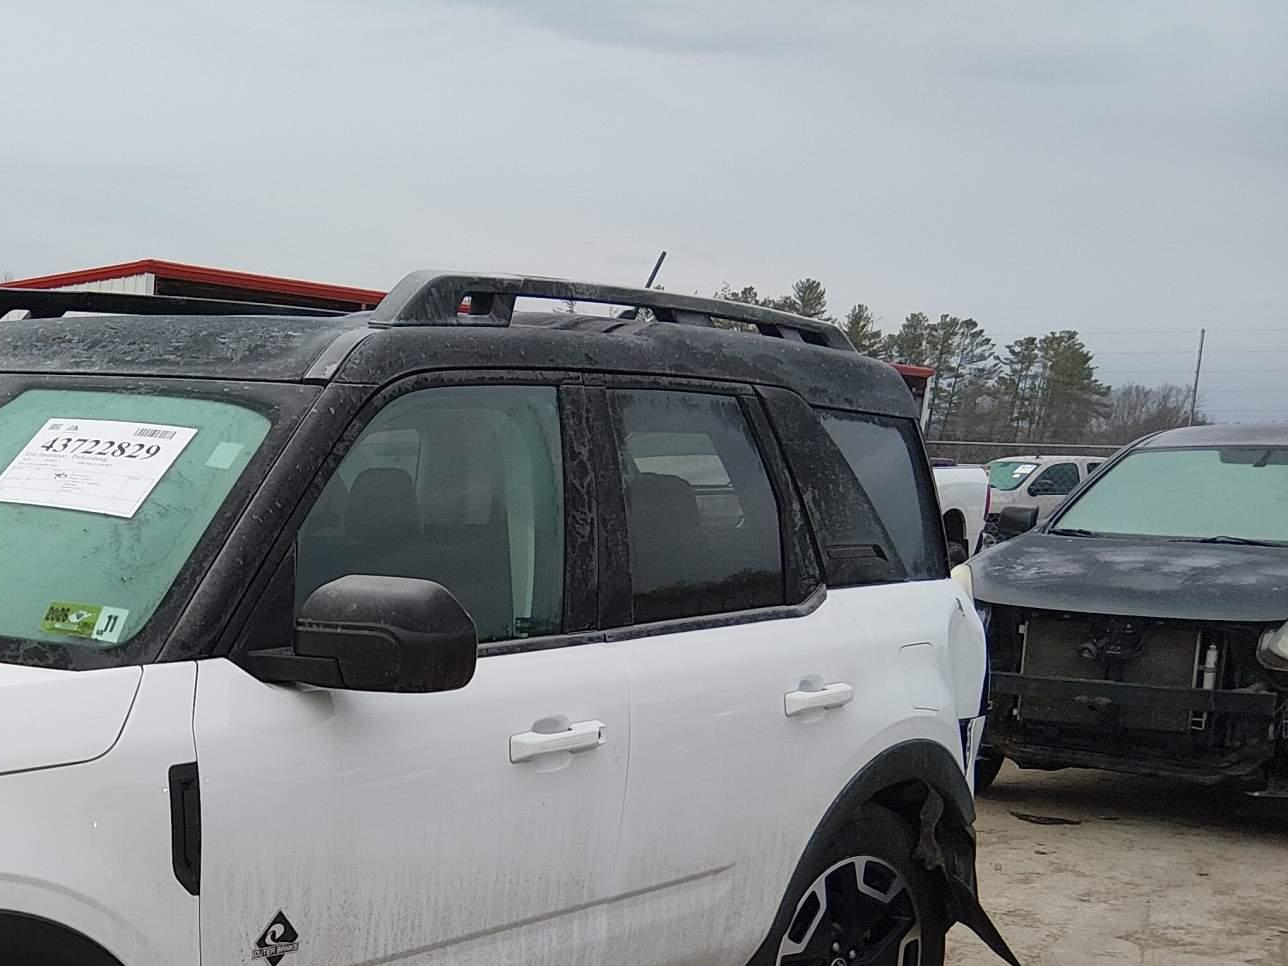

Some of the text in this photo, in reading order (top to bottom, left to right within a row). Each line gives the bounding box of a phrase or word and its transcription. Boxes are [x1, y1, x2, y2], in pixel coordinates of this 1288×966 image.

[40, 436, 161, 460] 43722829
[253, 943, 299, 958] OUTER BANKS
